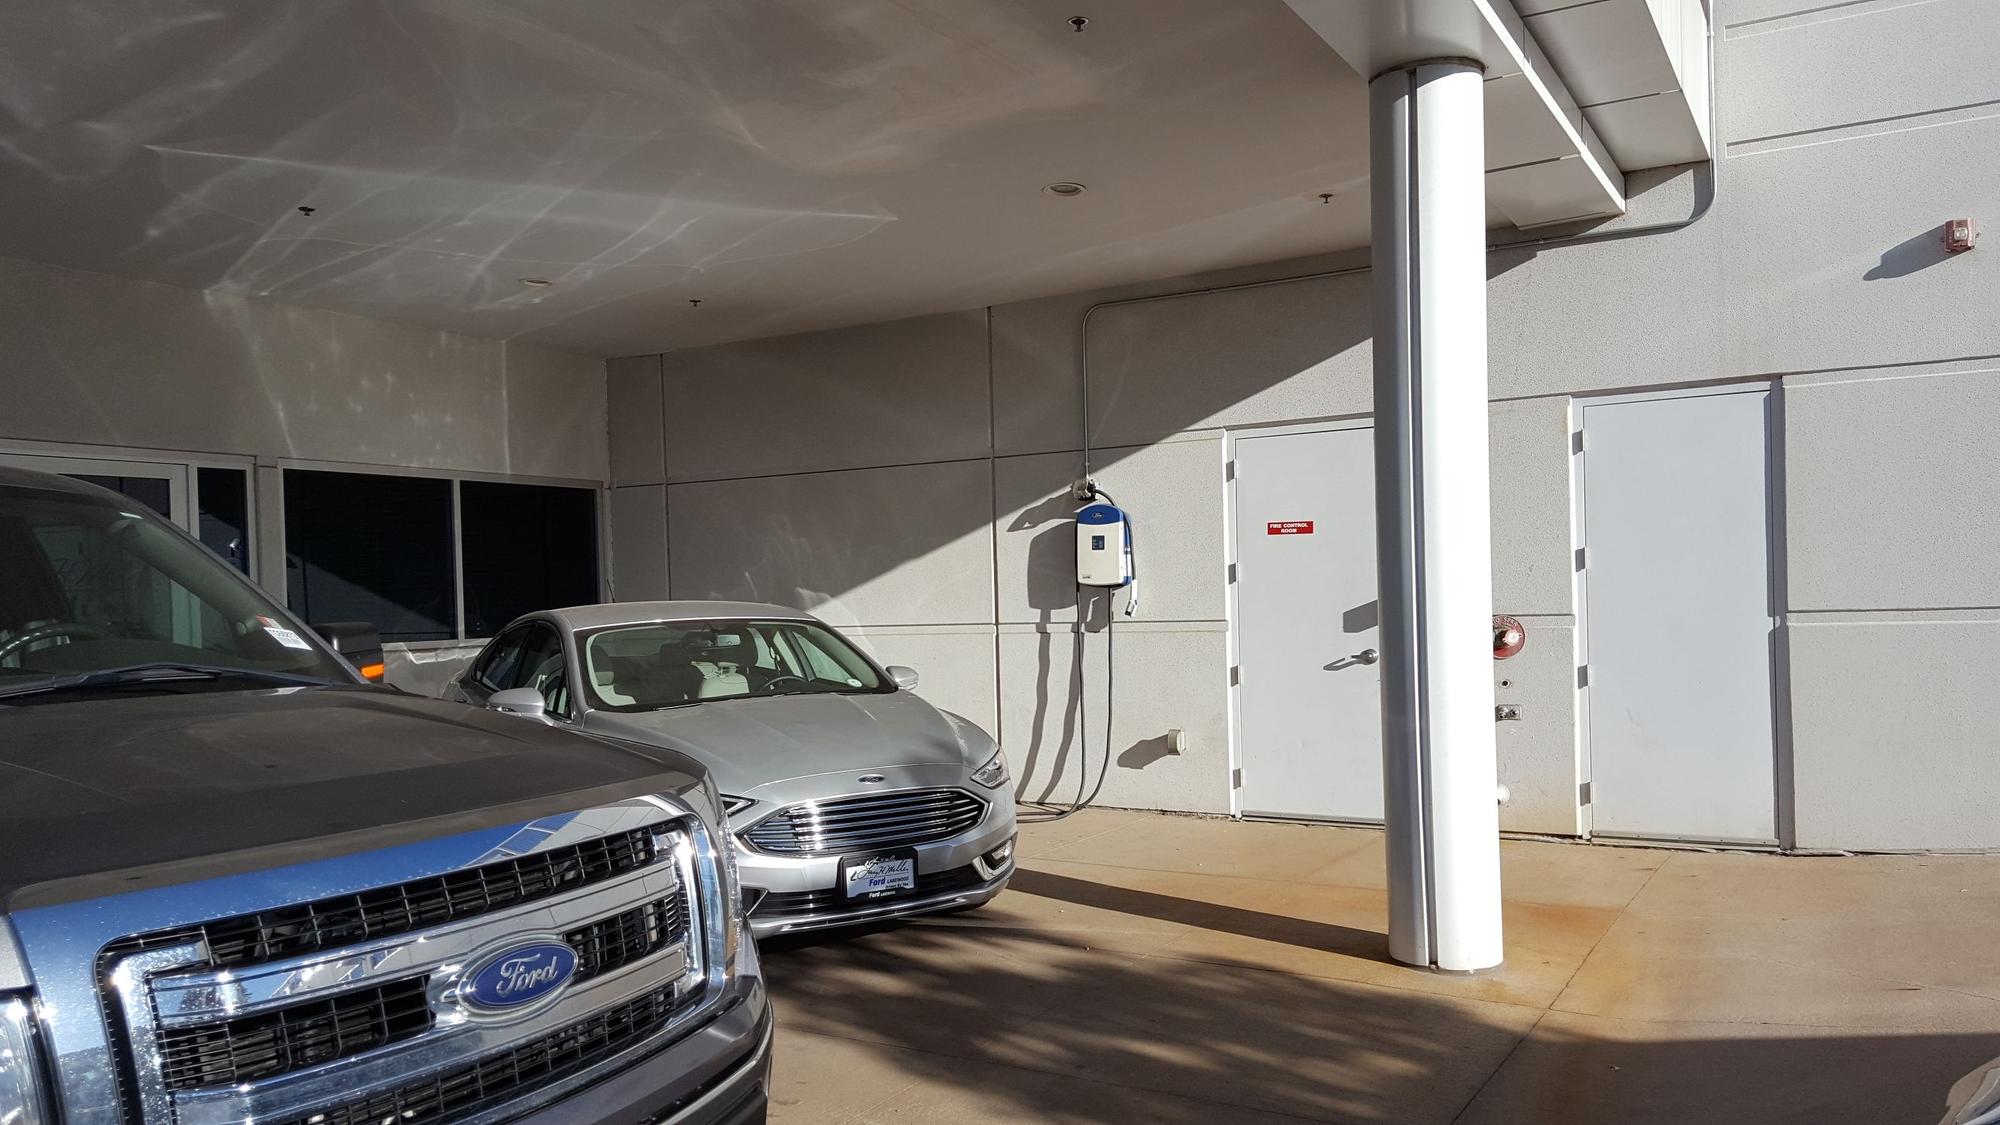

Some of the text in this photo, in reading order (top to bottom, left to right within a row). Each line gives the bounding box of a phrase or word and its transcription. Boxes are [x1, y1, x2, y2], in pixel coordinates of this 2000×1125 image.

[868, 876, 909, 887] Ford LAKEWOOD
[496, 953, 558, 998] Ford
